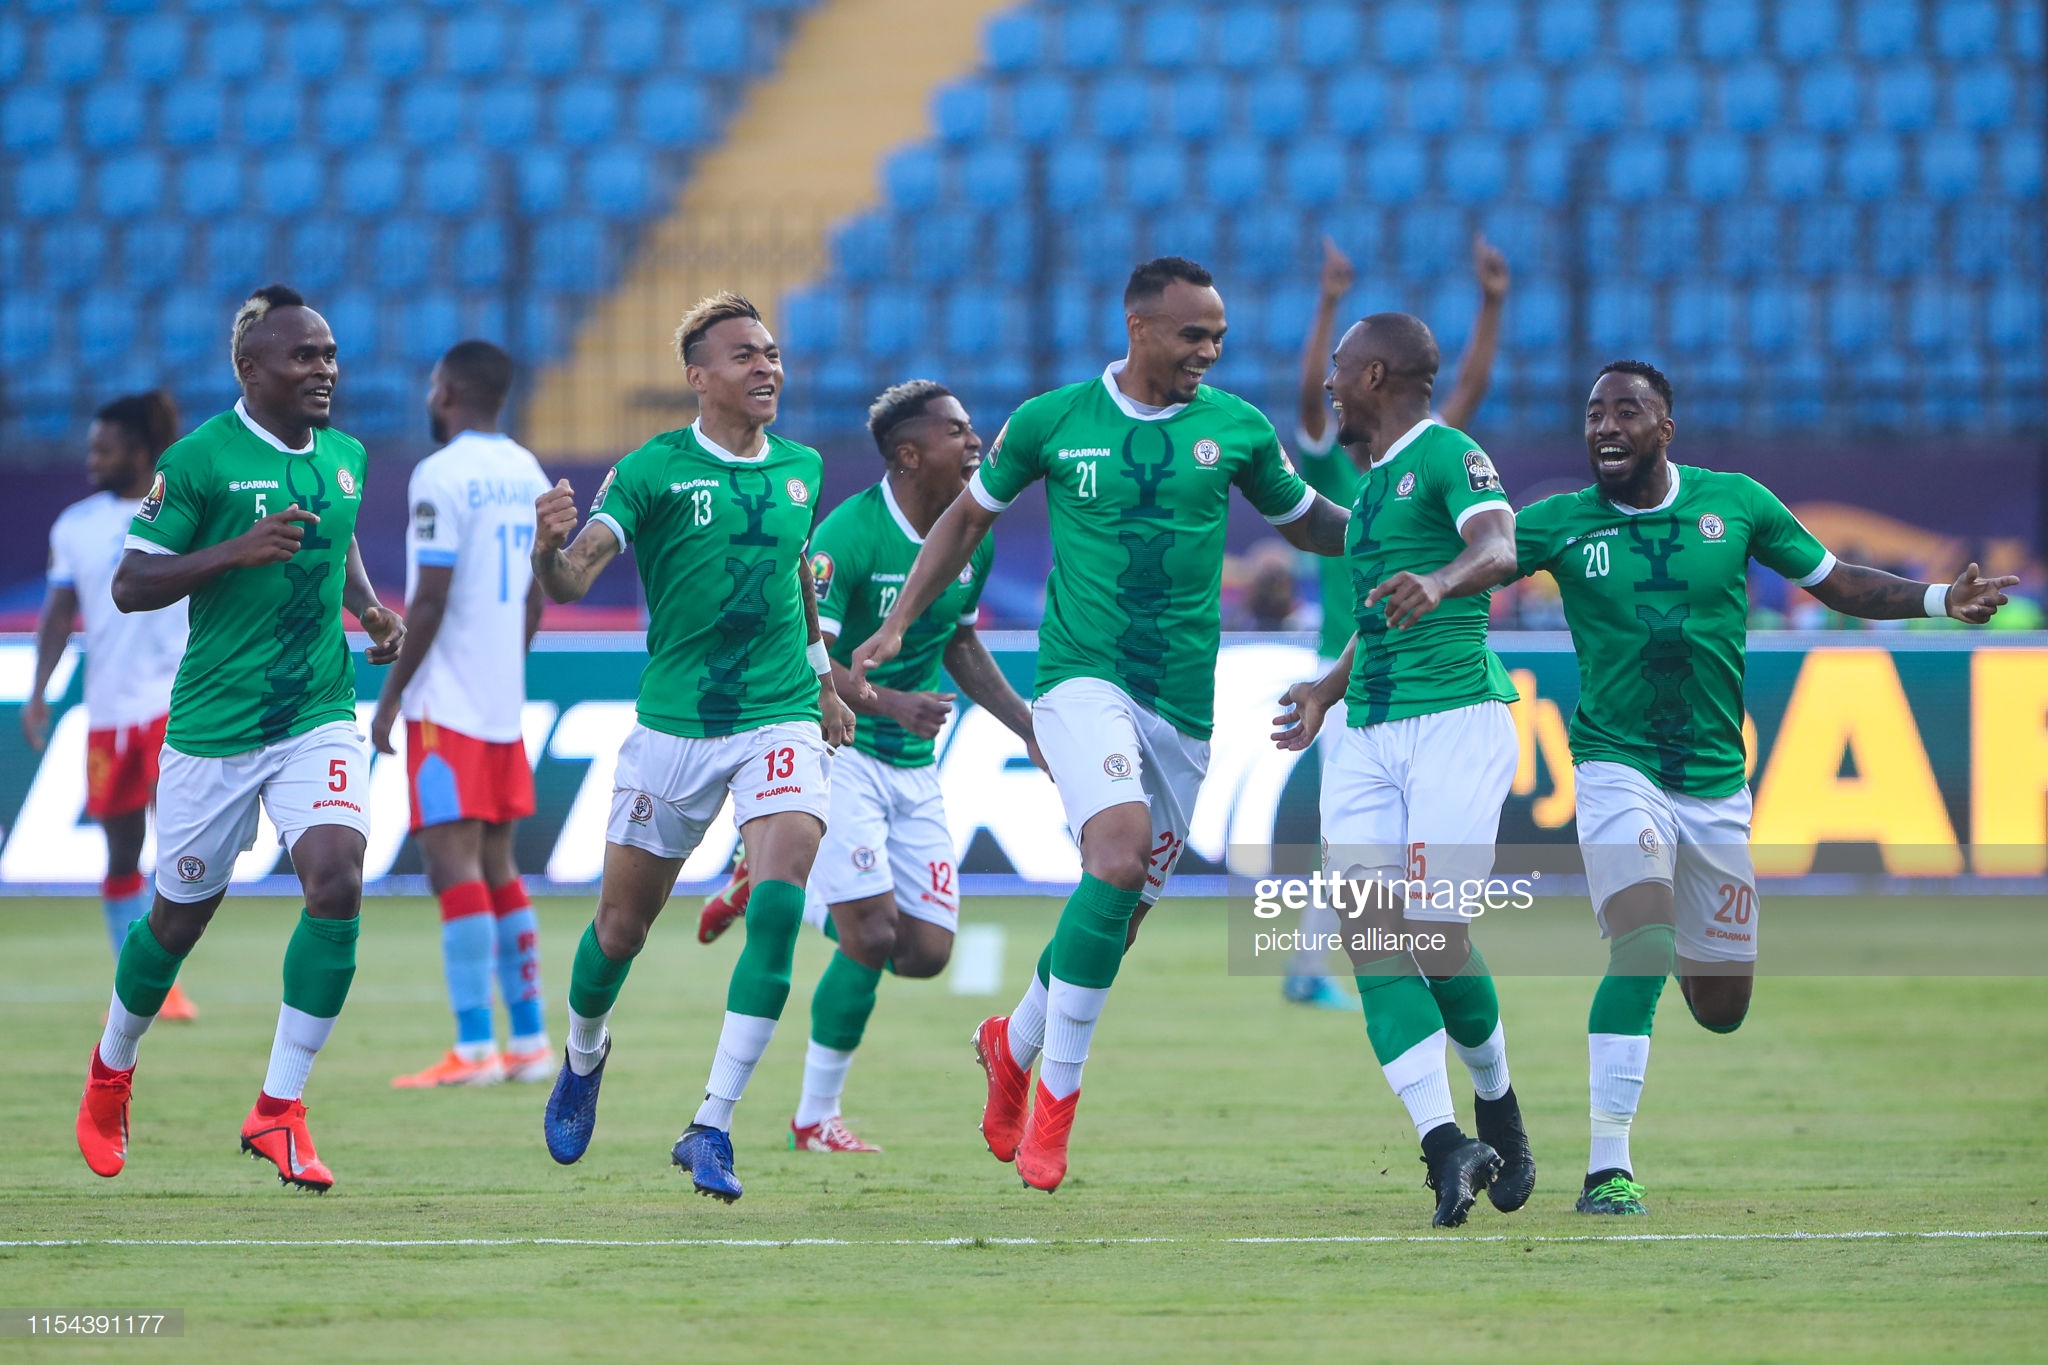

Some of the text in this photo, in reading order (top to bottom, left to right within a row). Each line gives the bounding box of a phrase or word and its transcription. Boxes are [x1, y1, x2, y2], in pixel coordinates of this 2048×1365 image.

[1069, 448, 1111, 458] GARMAN
[240, 480, 279, 490] GARMAN
[681, 479, 720, 491] GARMAN
[1076, 460, 1097, 498] 21
[254, 493, 268, 524] 5
[691, 489, 712, 527] 13
[495, 522, 535, 604] 17
[1582, 540, 1610, 579] 20
[877, 586, 899, 618] 12
[328, 759, 347, 793] 5
[763, 746, 795, 782] 13
[321, 799, 361, 813] GARMAN
[765, 785, 802, 798] GARMAN
[1150, 830, 1183, 873] 21
[928, 861, 953, 896] 12
[1713, 883, 1752, 925] 20
[1716, 930, 1752, 942] GARMAN
